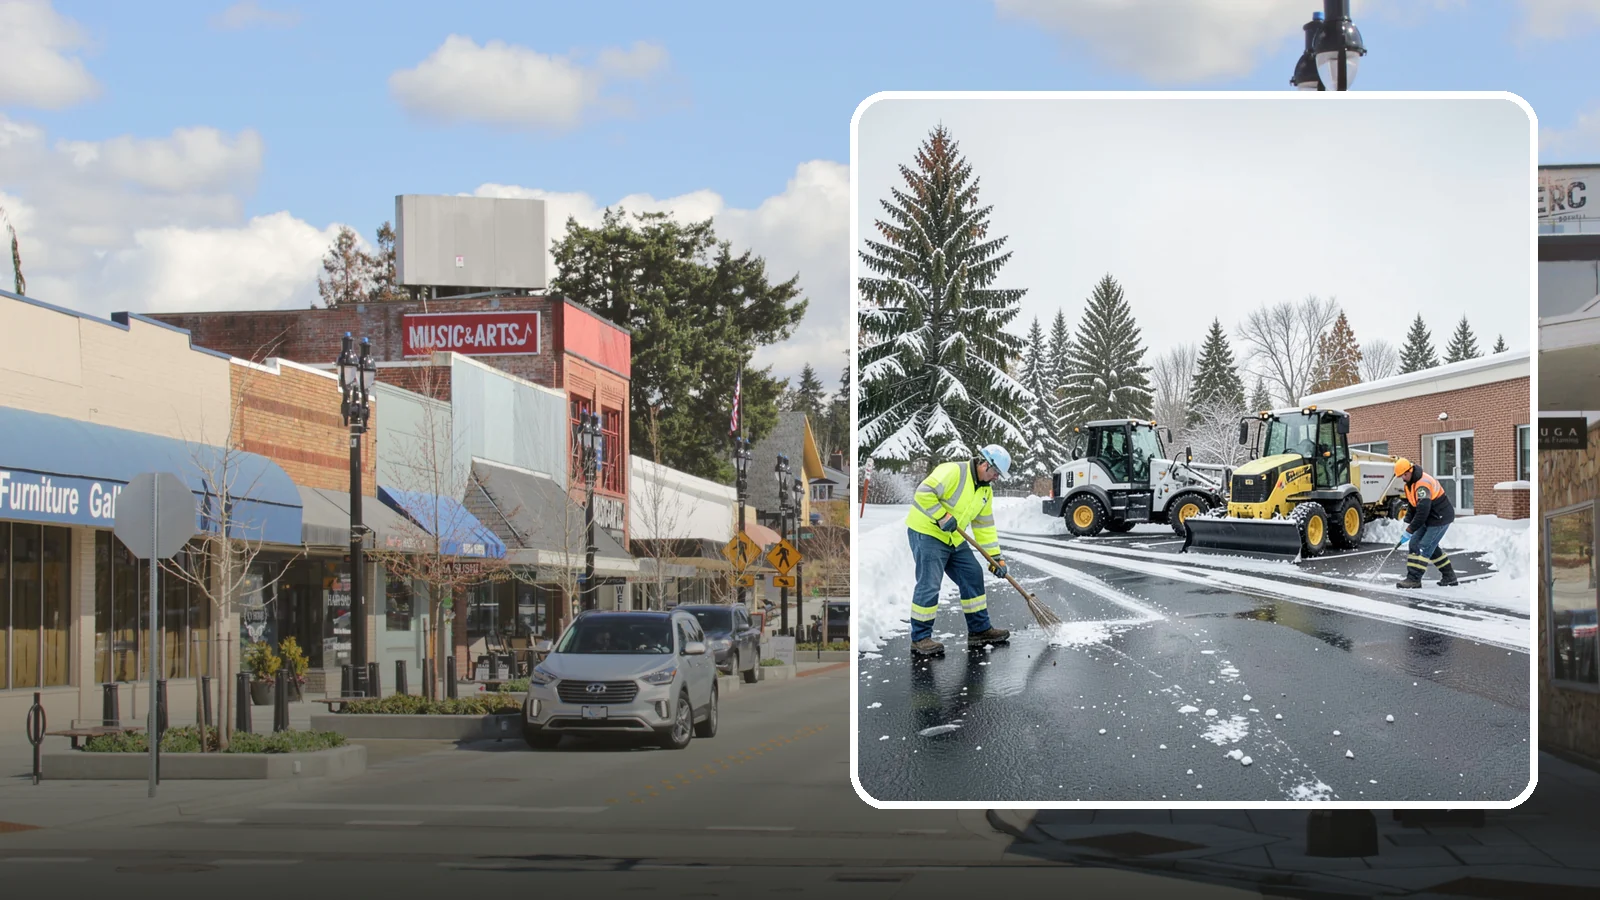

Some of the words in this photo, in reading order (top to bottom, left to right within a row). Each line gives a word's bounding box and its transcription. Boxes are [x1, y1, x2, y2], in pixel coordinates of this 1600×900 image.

[0, 472, 79, 515] Furniture
[89, 482, 122, 519] Gal
[453, 563, 479, 574] SUSHI
